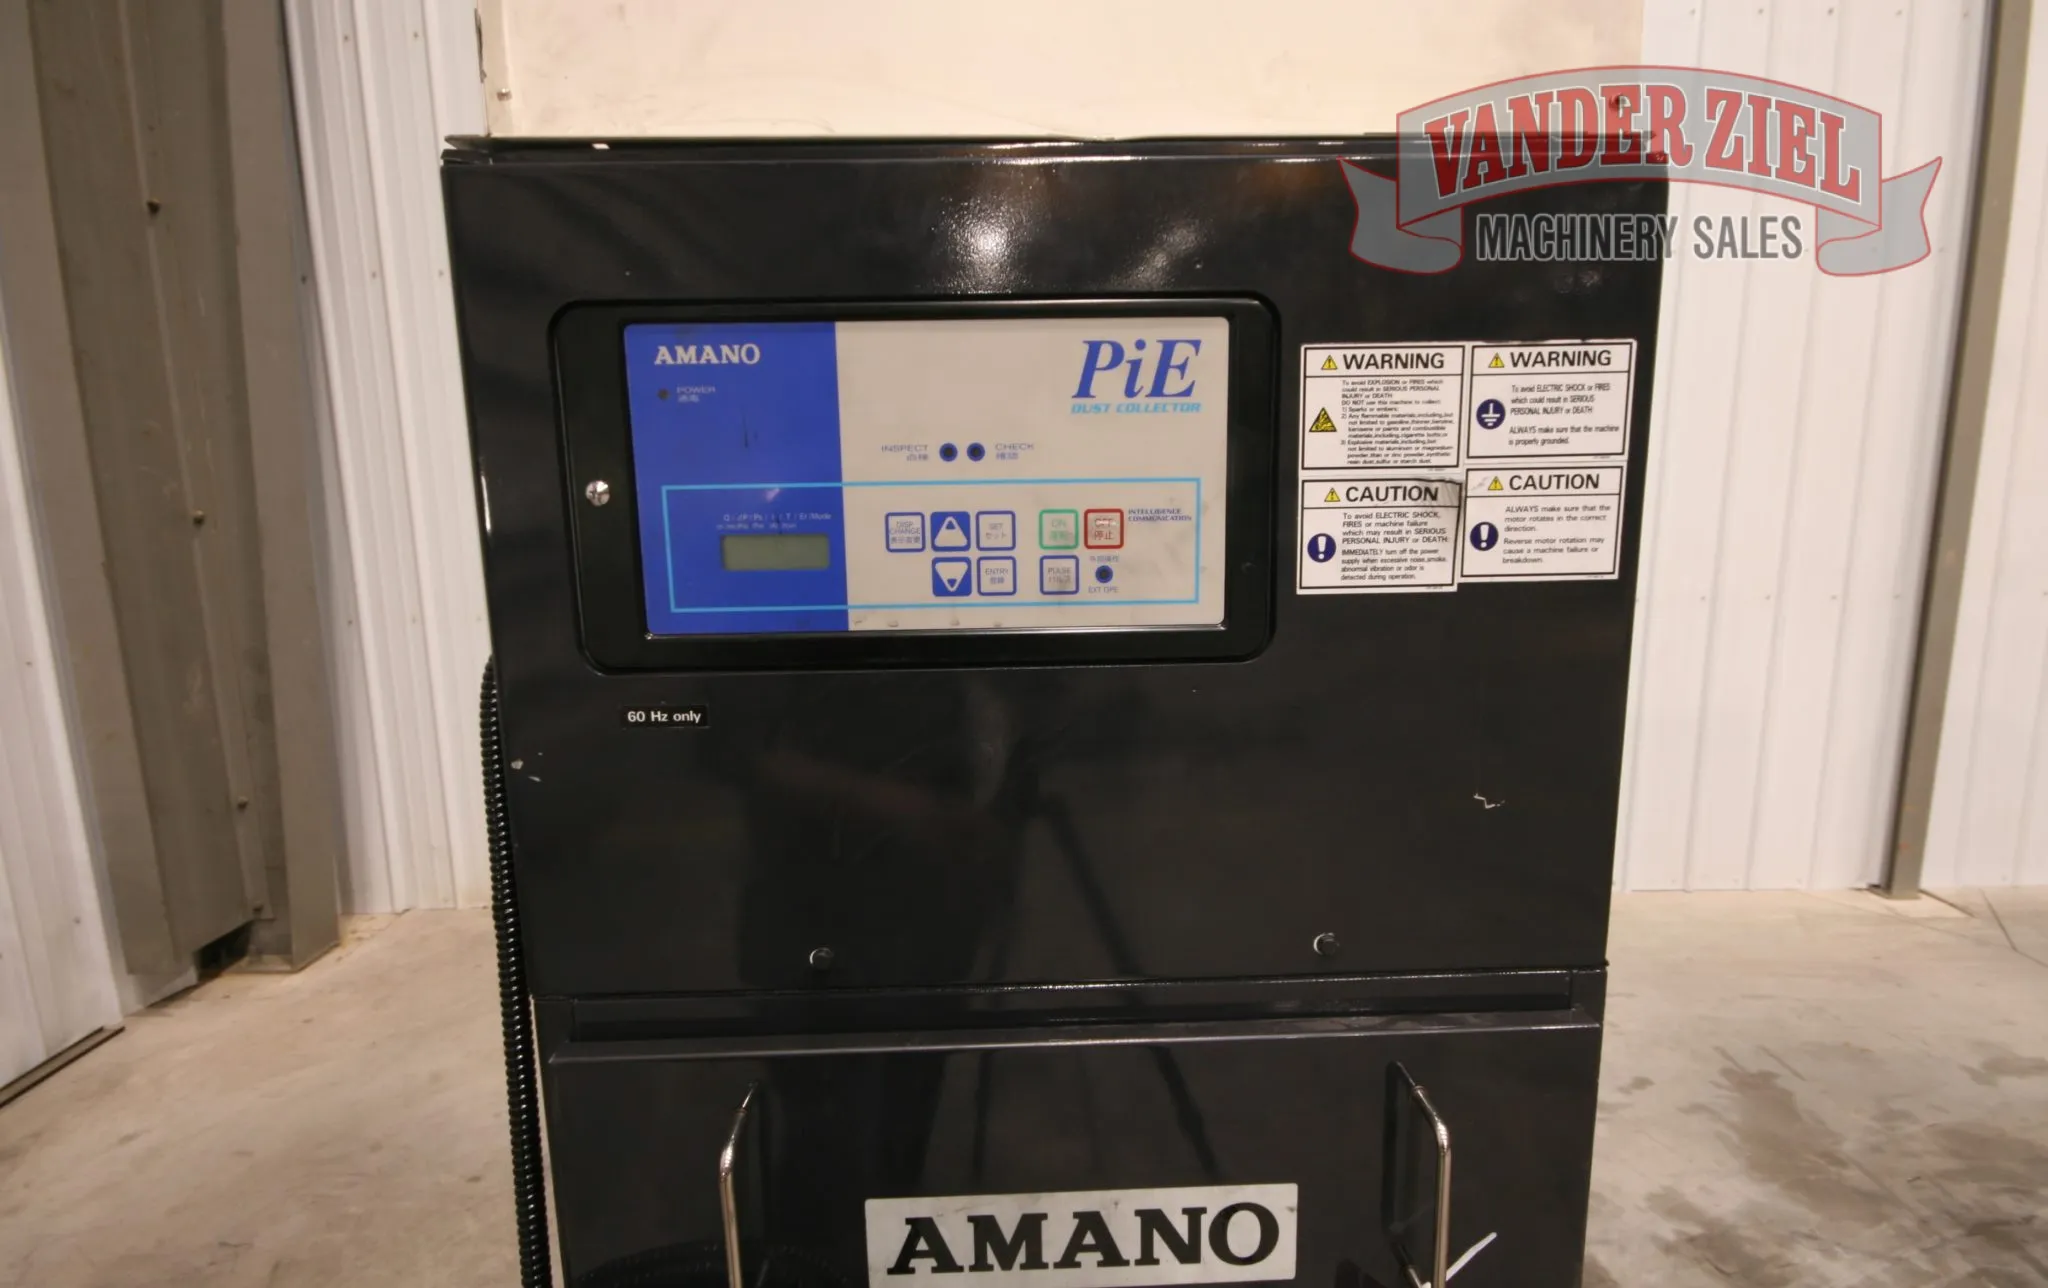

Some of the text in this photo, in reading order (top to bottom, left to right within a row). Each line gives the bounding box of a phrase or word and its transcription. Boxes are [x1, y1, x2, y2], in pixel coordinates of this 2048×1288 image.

[654, 344, 760, 365] AMANO
[1510, 350, 1611, 367] WARNING
[1343, 353, 1444, 369] WARNING
[1072, 339, 1201, 398] PiE
[677, 385, 715, 394] POWER
[1537, 384, 1562, 392] ELECTRIC
[1595, 383, 1610, 391] FIRES
[1570, 395, 1594, 403] SERIOUS
[1071, 402, 1202, 414] DUST COLLECTOR
[1511, 407, 1540, 415] PERSONAL
[1510, 426, 1536, 434] ALWAYS
[882, 444, 928, 452] INSPECT
[995, 442, 1034, 451] CHECK
[1509, 474, 1600, 491] CAUTION
[1346, 486, 1438, 502] CAUTION
[628, 710, 701, 723] 60 Hz only
[887, 1202, 1279, 1275] AMANO
